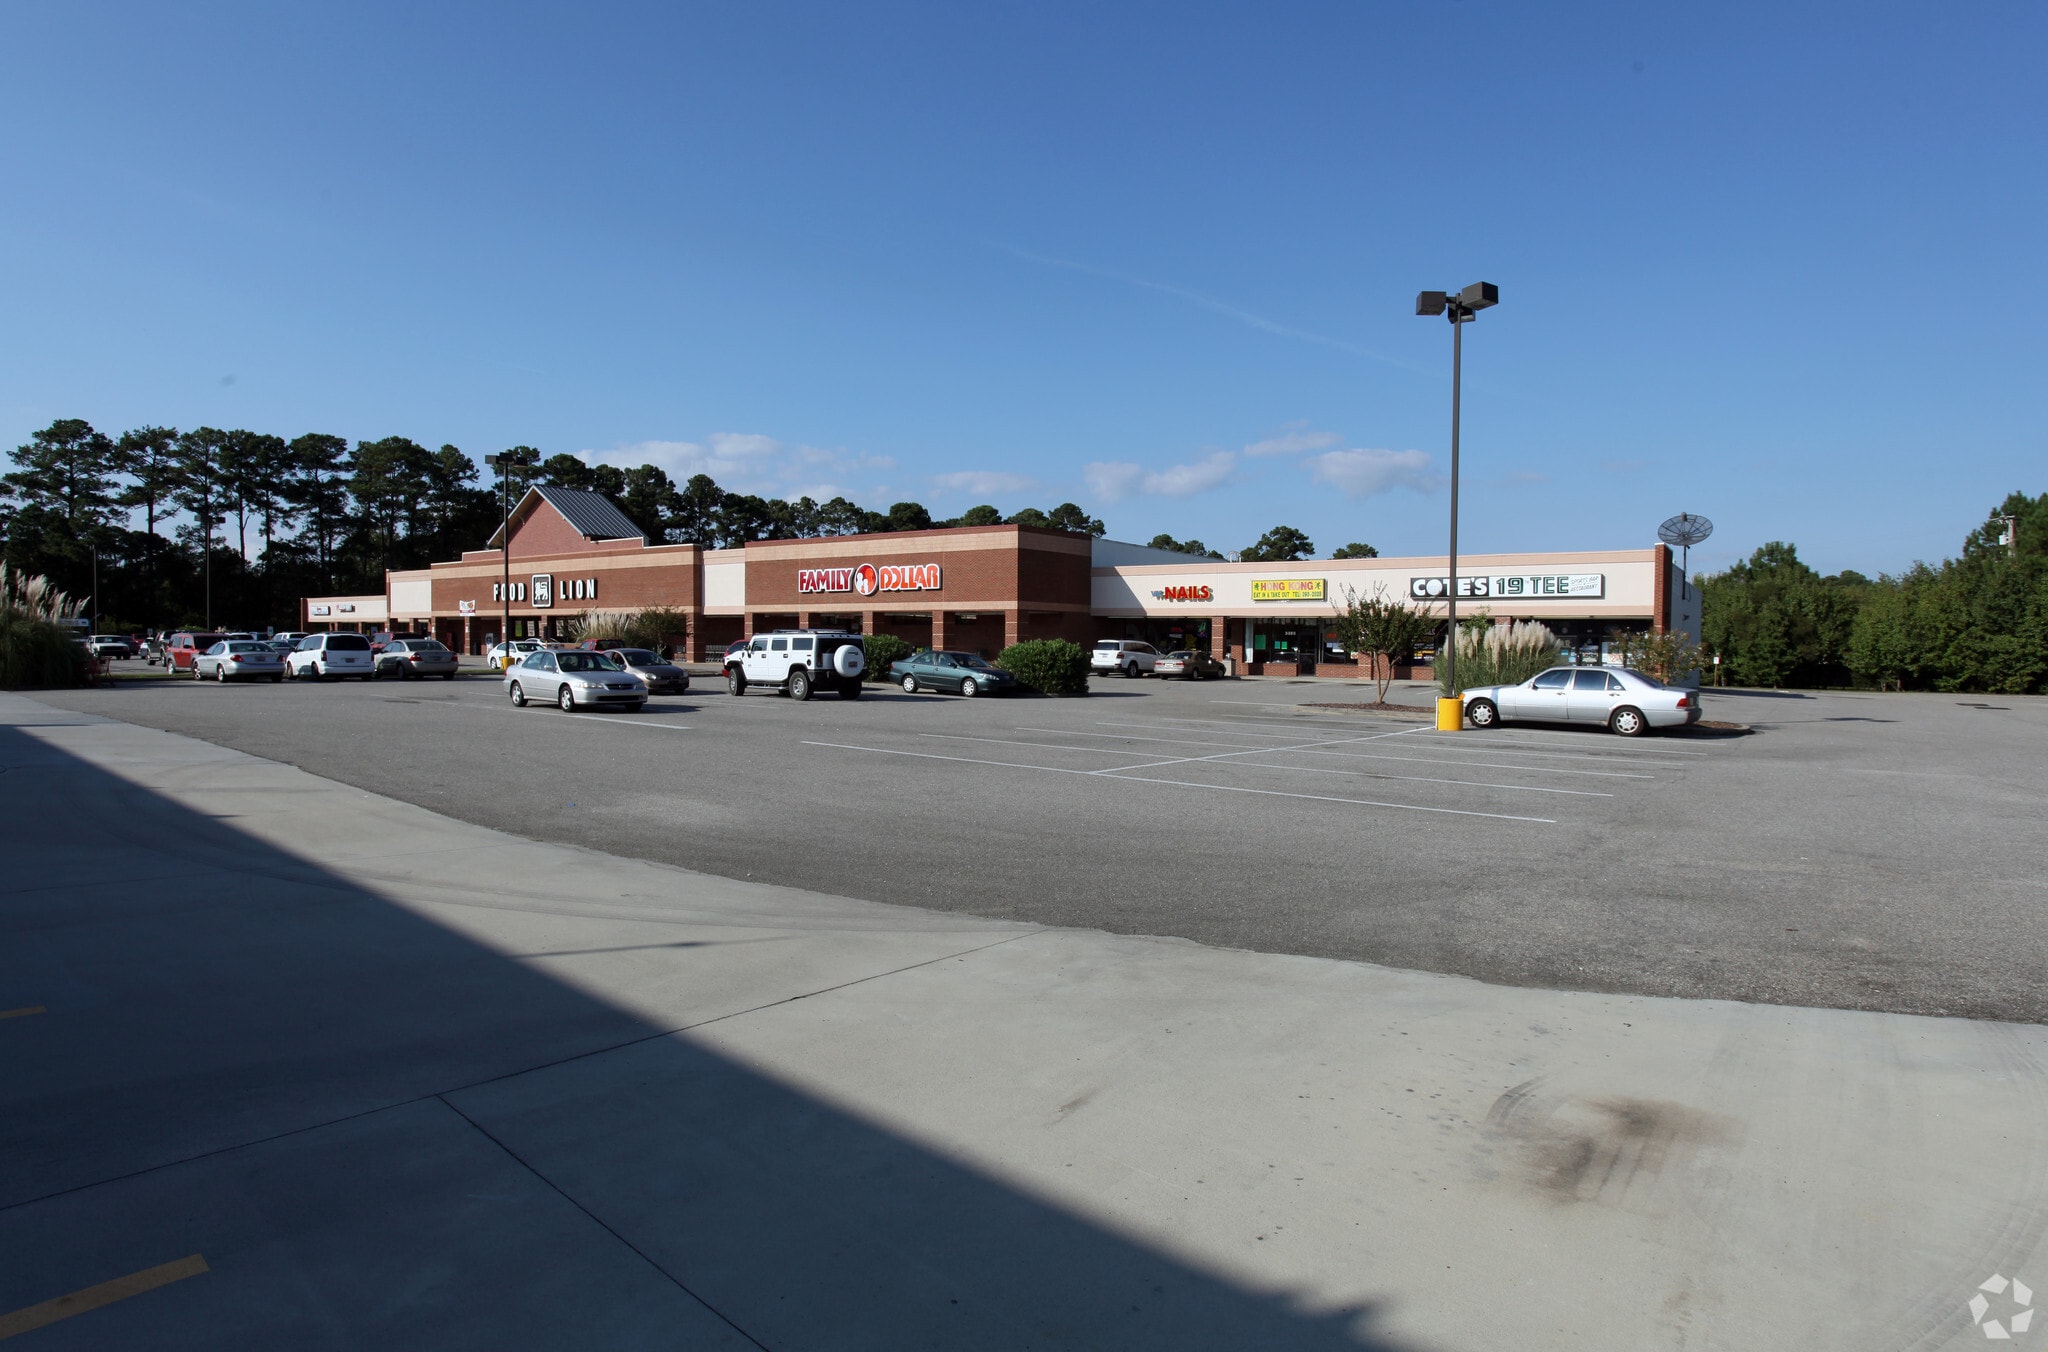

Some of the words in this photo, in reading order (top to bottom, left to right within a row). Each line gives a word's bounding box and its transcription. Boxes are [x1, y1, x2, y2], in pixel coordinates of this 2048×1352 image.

[799, 568, 853, 592] FAMILY
[879, 564, 940, 590] DOLLAR
[1260, 582, 1285, 591] HONG
[1289, 581, 1314, 590] KONG
[1496, 576, 1523, 595] 19
[1530, 576, 1568, 594] TEE
[493, 582, 525, 602] FOOD
[559, 578, 595, 599] LION
[1164, 585, 1209, 599] NAILS
